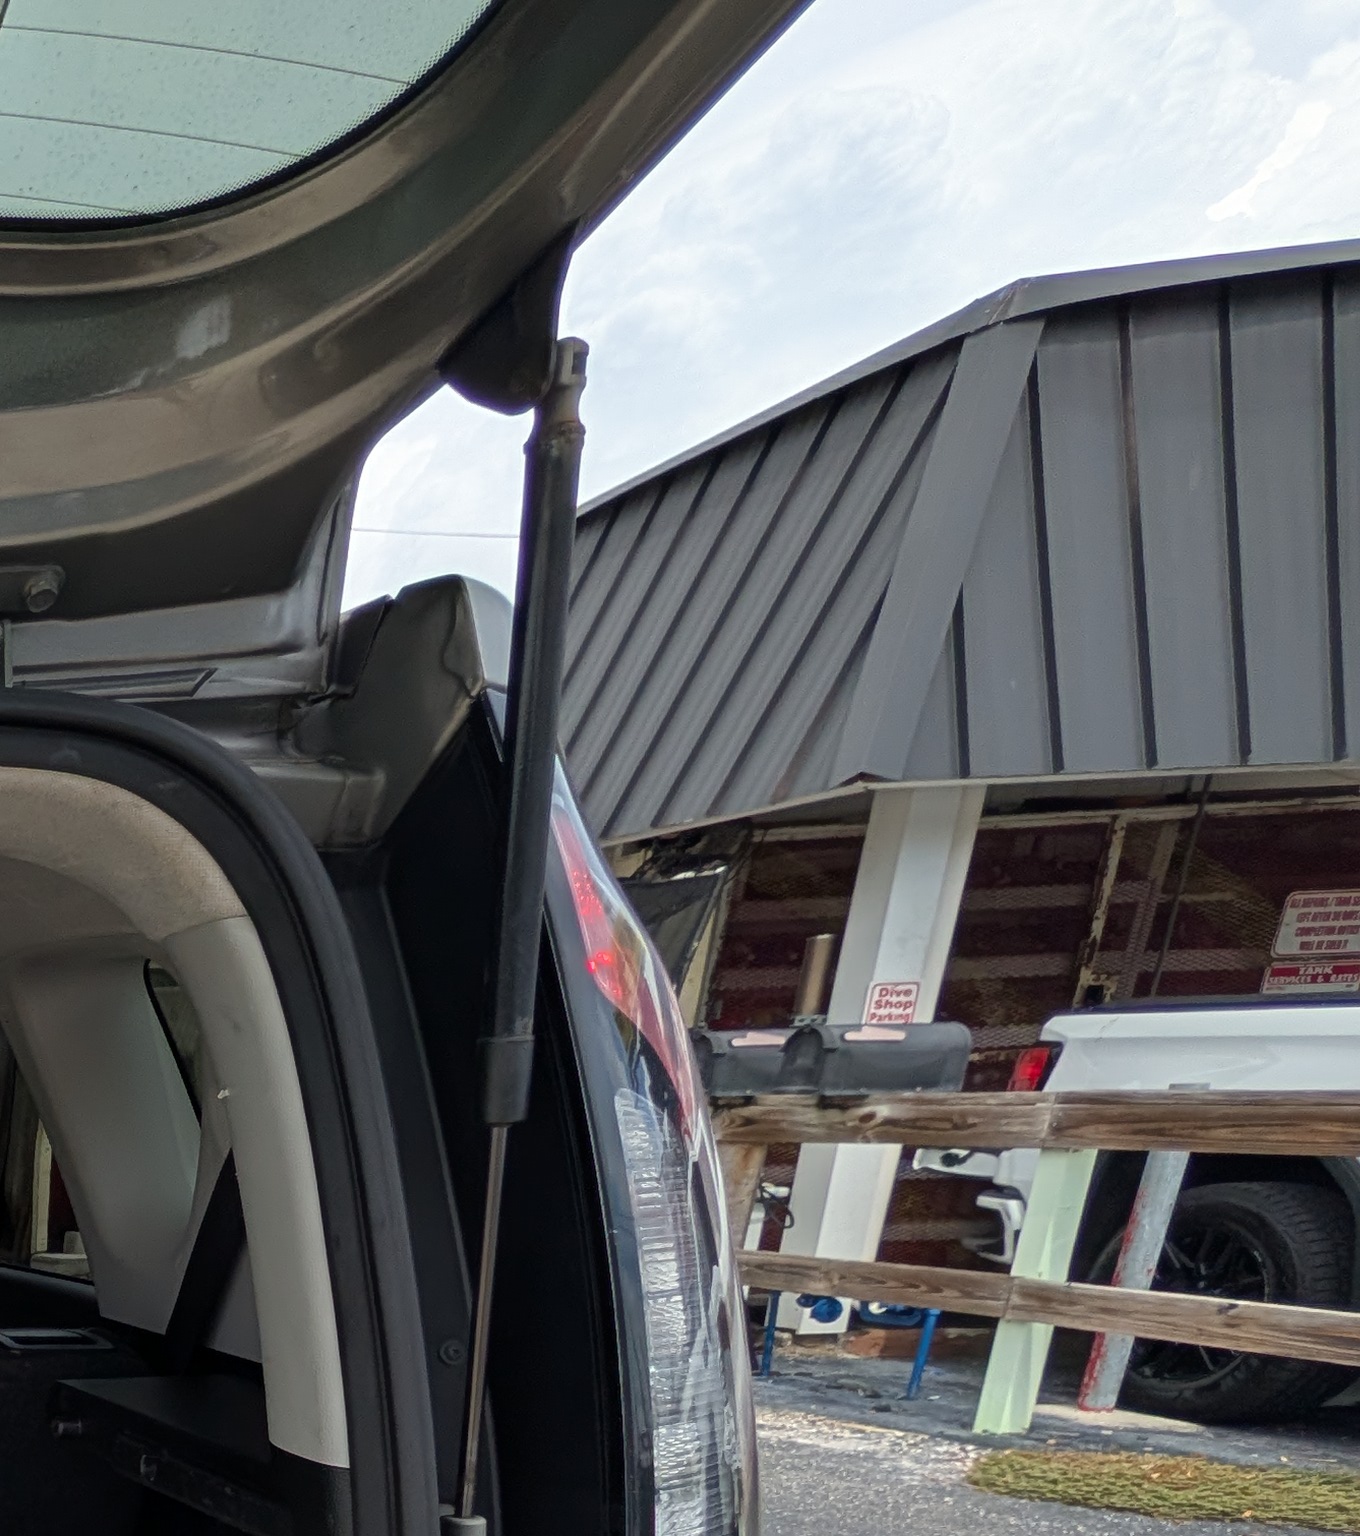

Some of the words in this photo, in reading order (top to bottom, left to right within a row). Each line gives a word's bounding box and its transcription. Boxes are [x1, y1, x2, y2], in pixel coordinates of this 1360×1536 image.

[1298, 966, 1334, 974] TANK
[879, 988, 912, 998] Dive
[874, 998, 913, 1011] Shop
[870, 1012, 910, 1024] Parking
